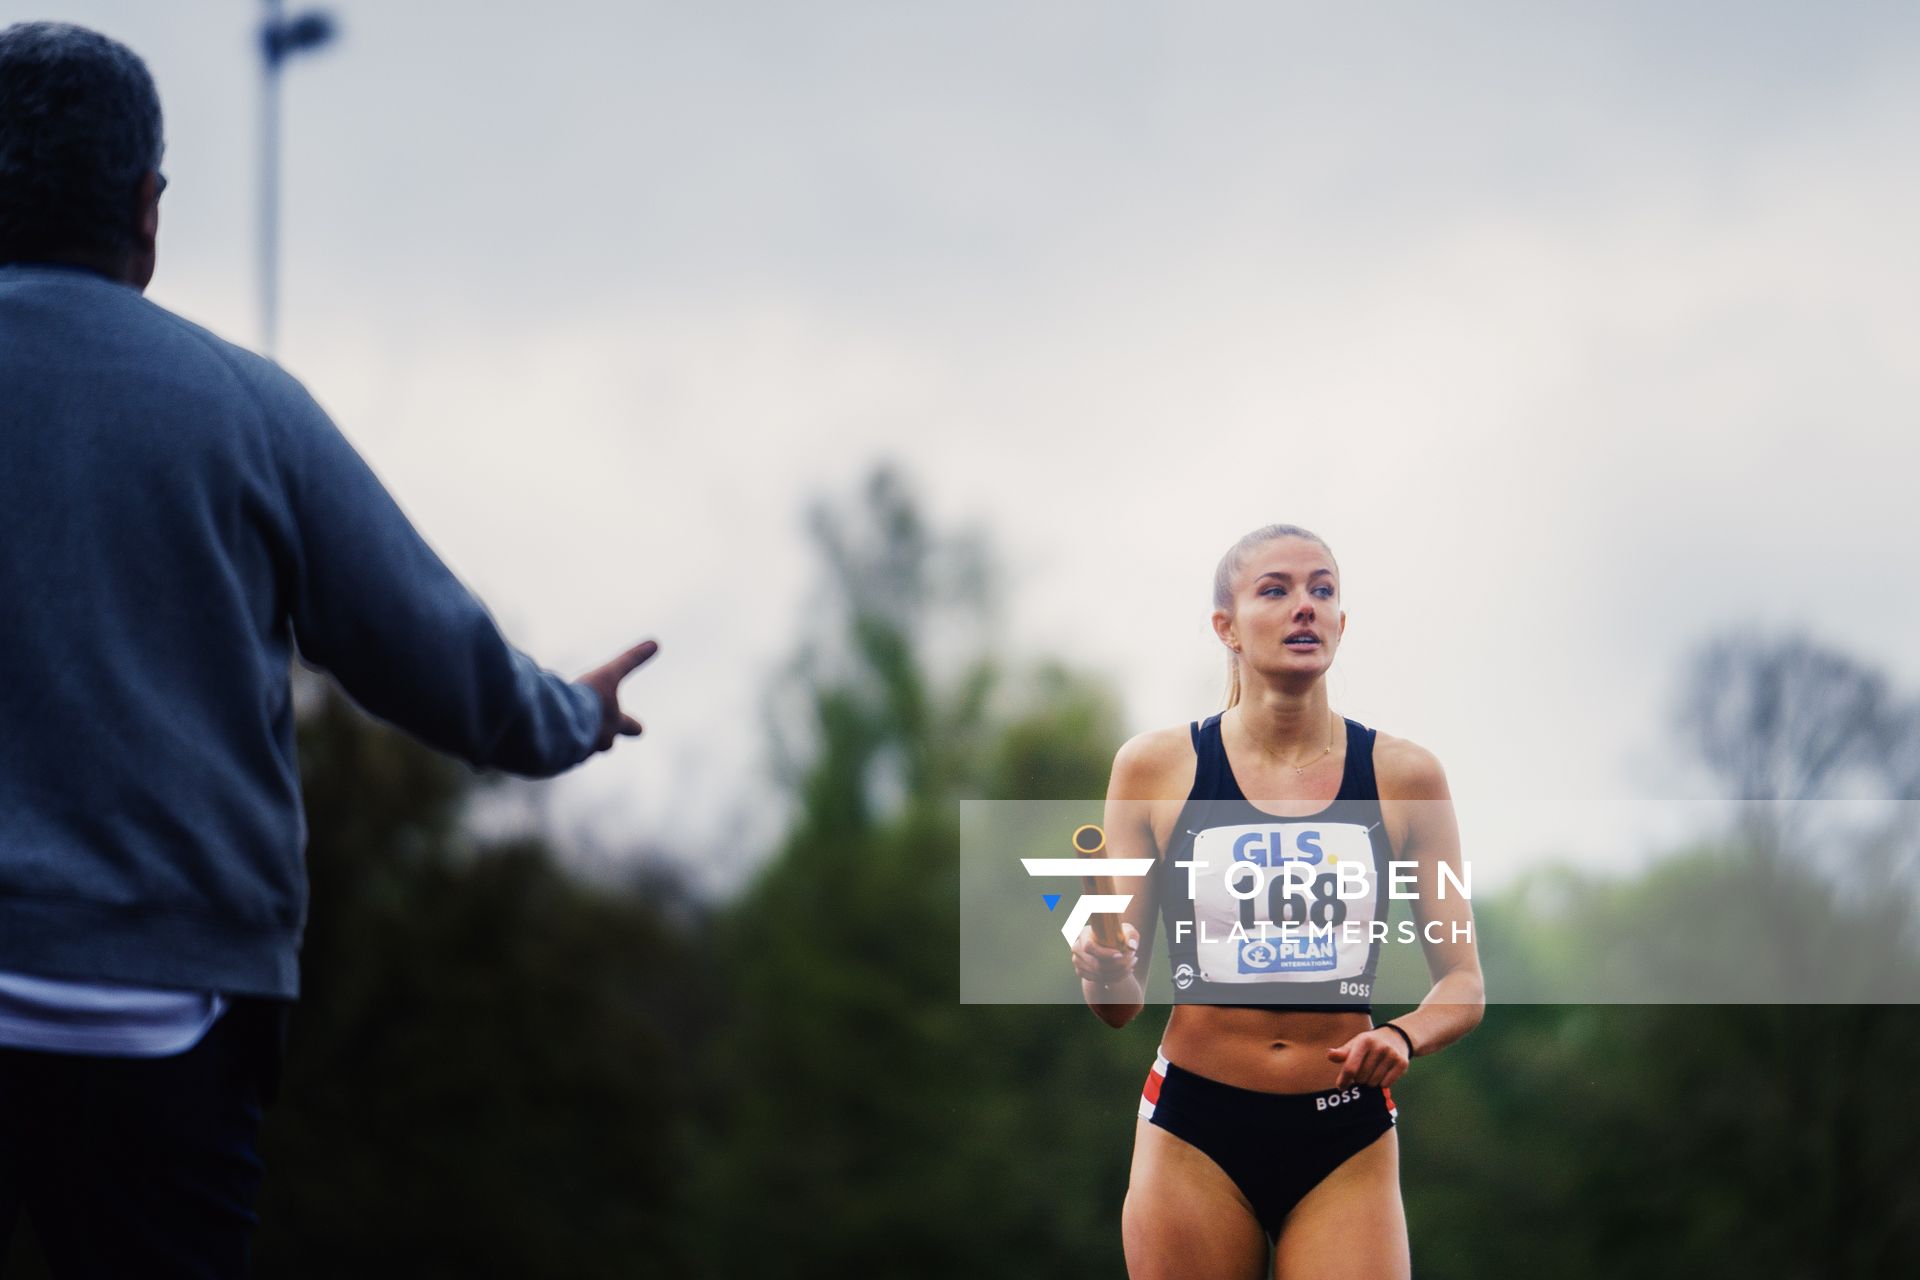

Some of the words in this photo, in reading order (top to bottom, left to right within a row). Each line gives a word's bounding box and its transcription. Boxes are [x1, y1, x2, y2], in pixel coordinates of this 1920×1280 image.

[1232, 873, 1347, 929] 168
[1280, 941, 1334, 960] PLAN
[1280, 959, 1334, 968] INTERNATIONAL
[1340, 981, 1370, 997] BOSS
[1315, 1087, 1361, 1111] BOSS
